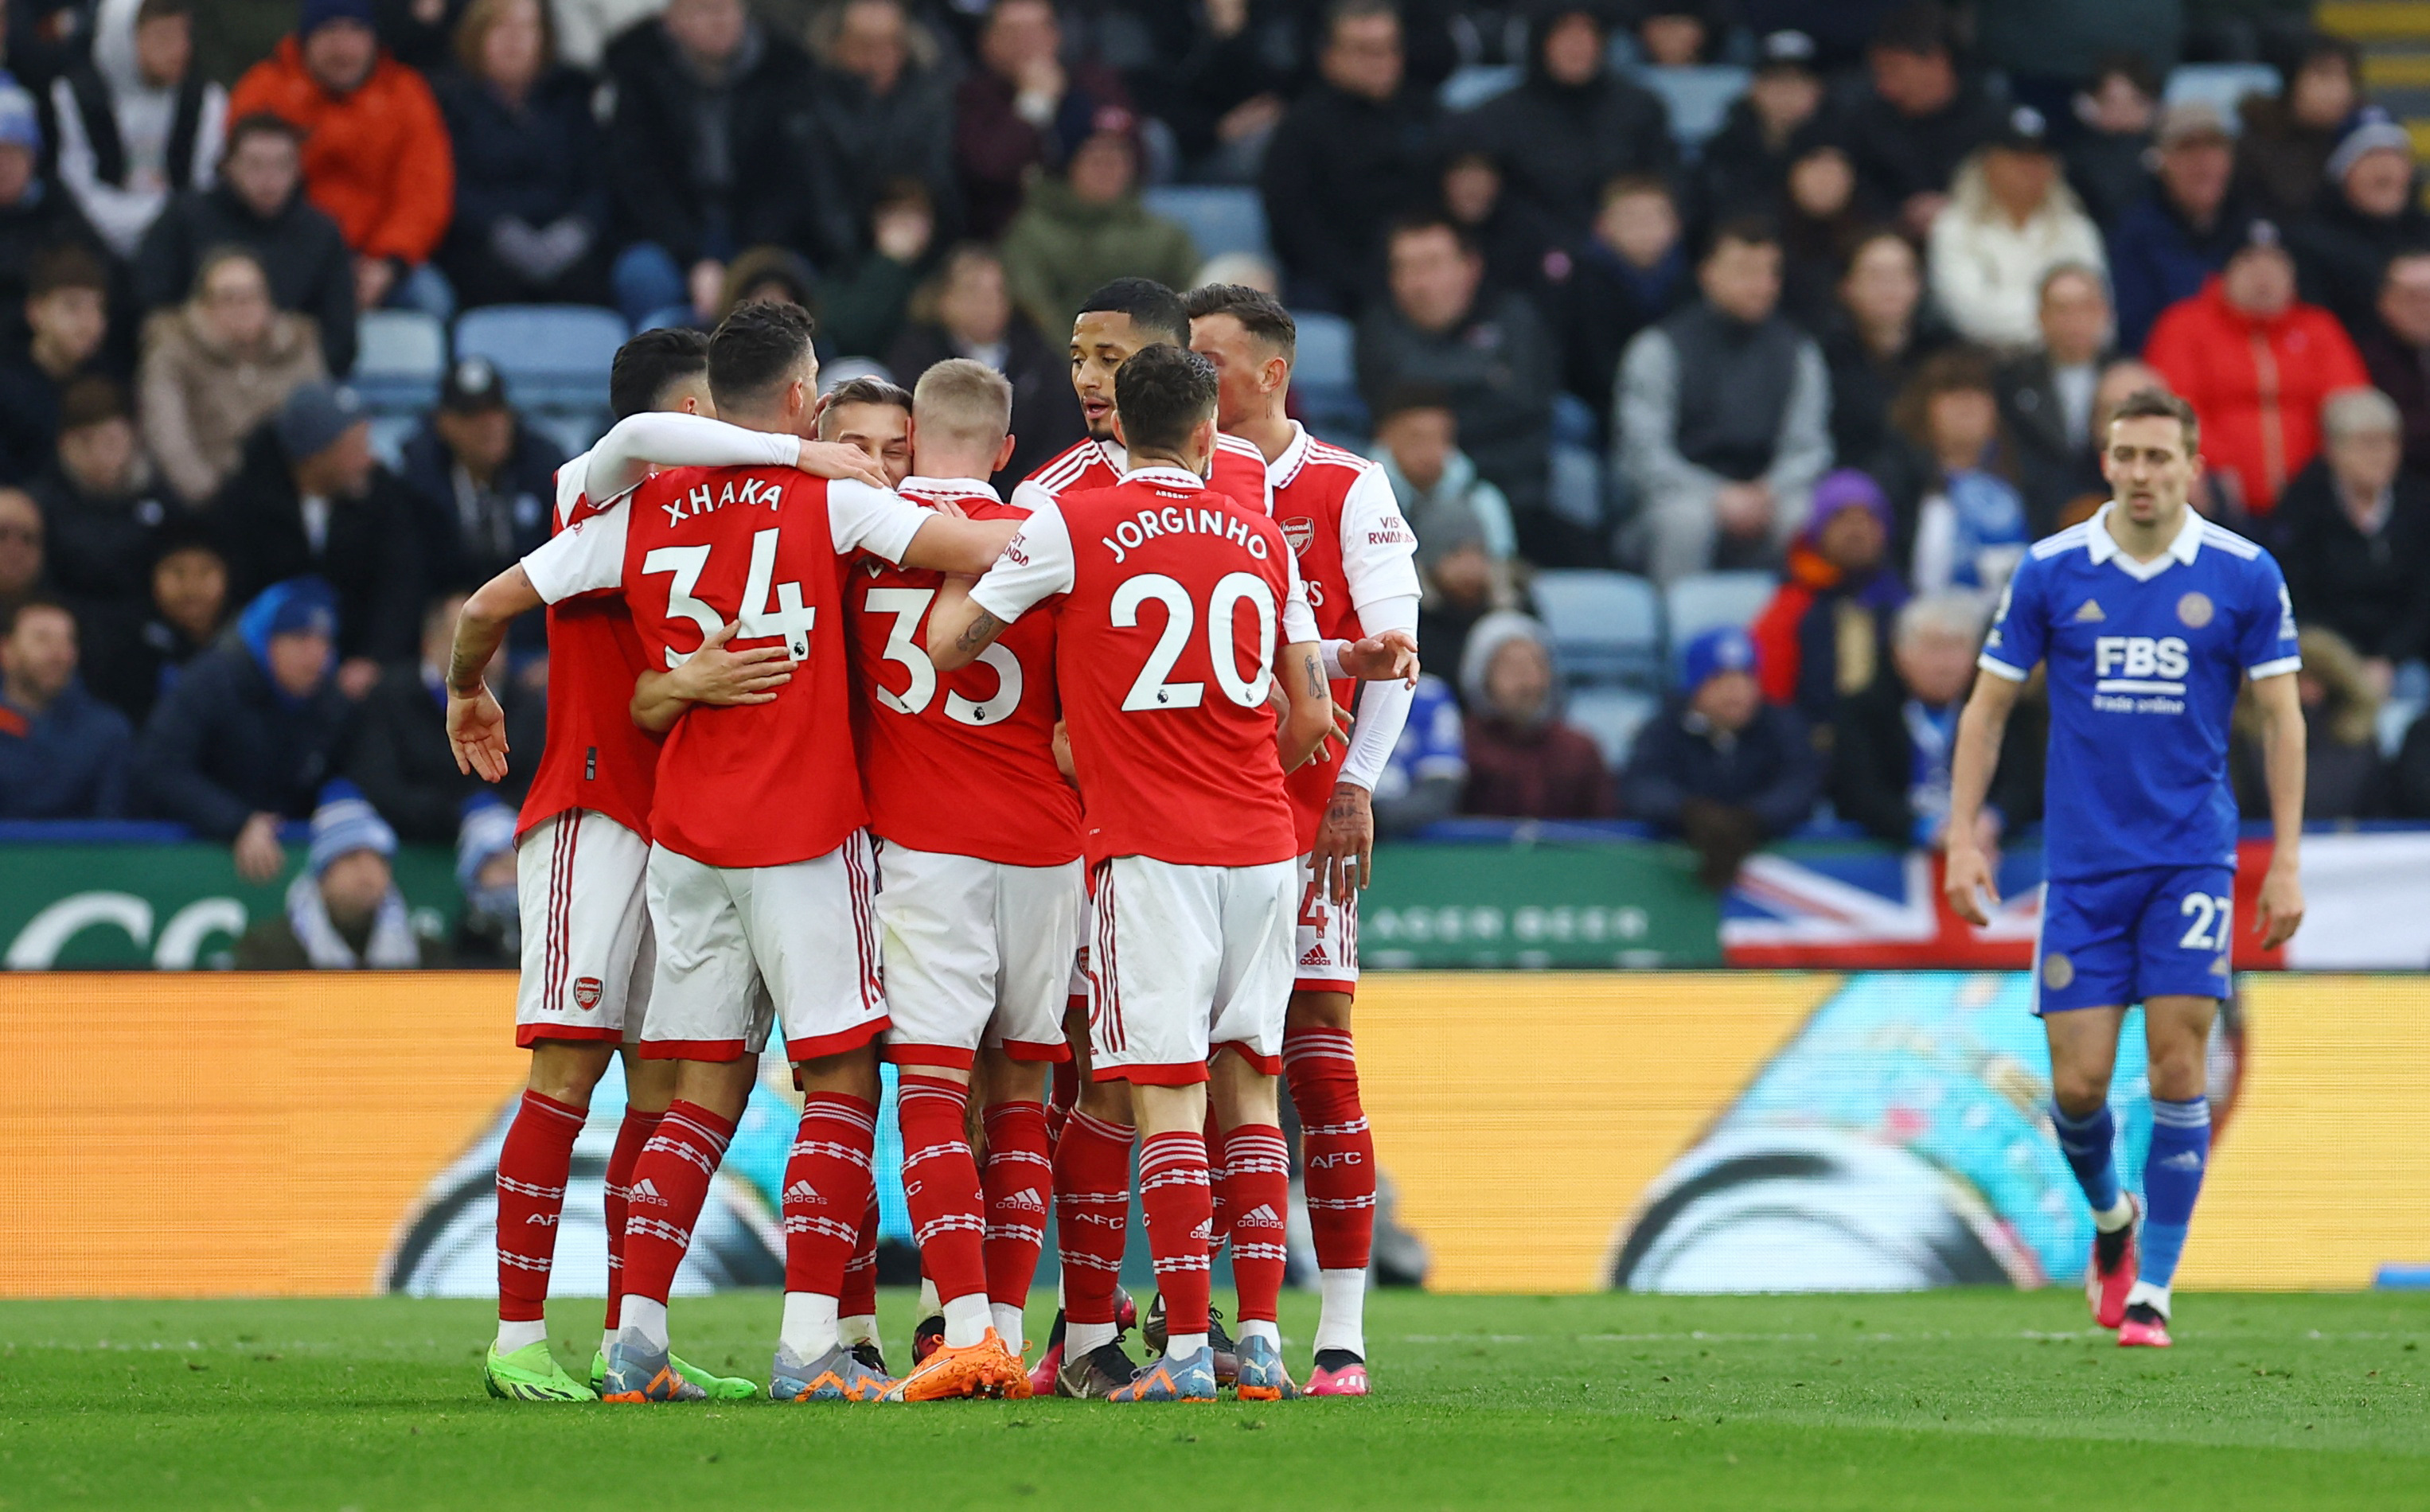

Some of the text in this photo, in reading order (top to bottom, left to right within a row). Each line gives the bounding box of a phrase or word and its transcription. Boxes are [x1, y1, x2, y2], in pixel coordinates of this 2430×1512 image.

[661, 477, 782, 528] XHAKA
[1102, 506, 1268, 563] JORGINHO
[642, 527, 817, 668] 34
[1110, 571, 1277, 711] 20
[2095, 636, 2190, 679] FBS
[2092, 694, 2186, 715] trade online
[2179, 891, 2233, 952] 27
[1300, 957, 1332, 966] adidas
[1310, 1152, 1363, 1169] AFC
[996, 1202, 1046, 1215] adidas
[525, 1213, 560, 1226] AF
[1075, 1213, 1125, 1230] AFC
[1237, 1218, 1285, 1229] adidas
